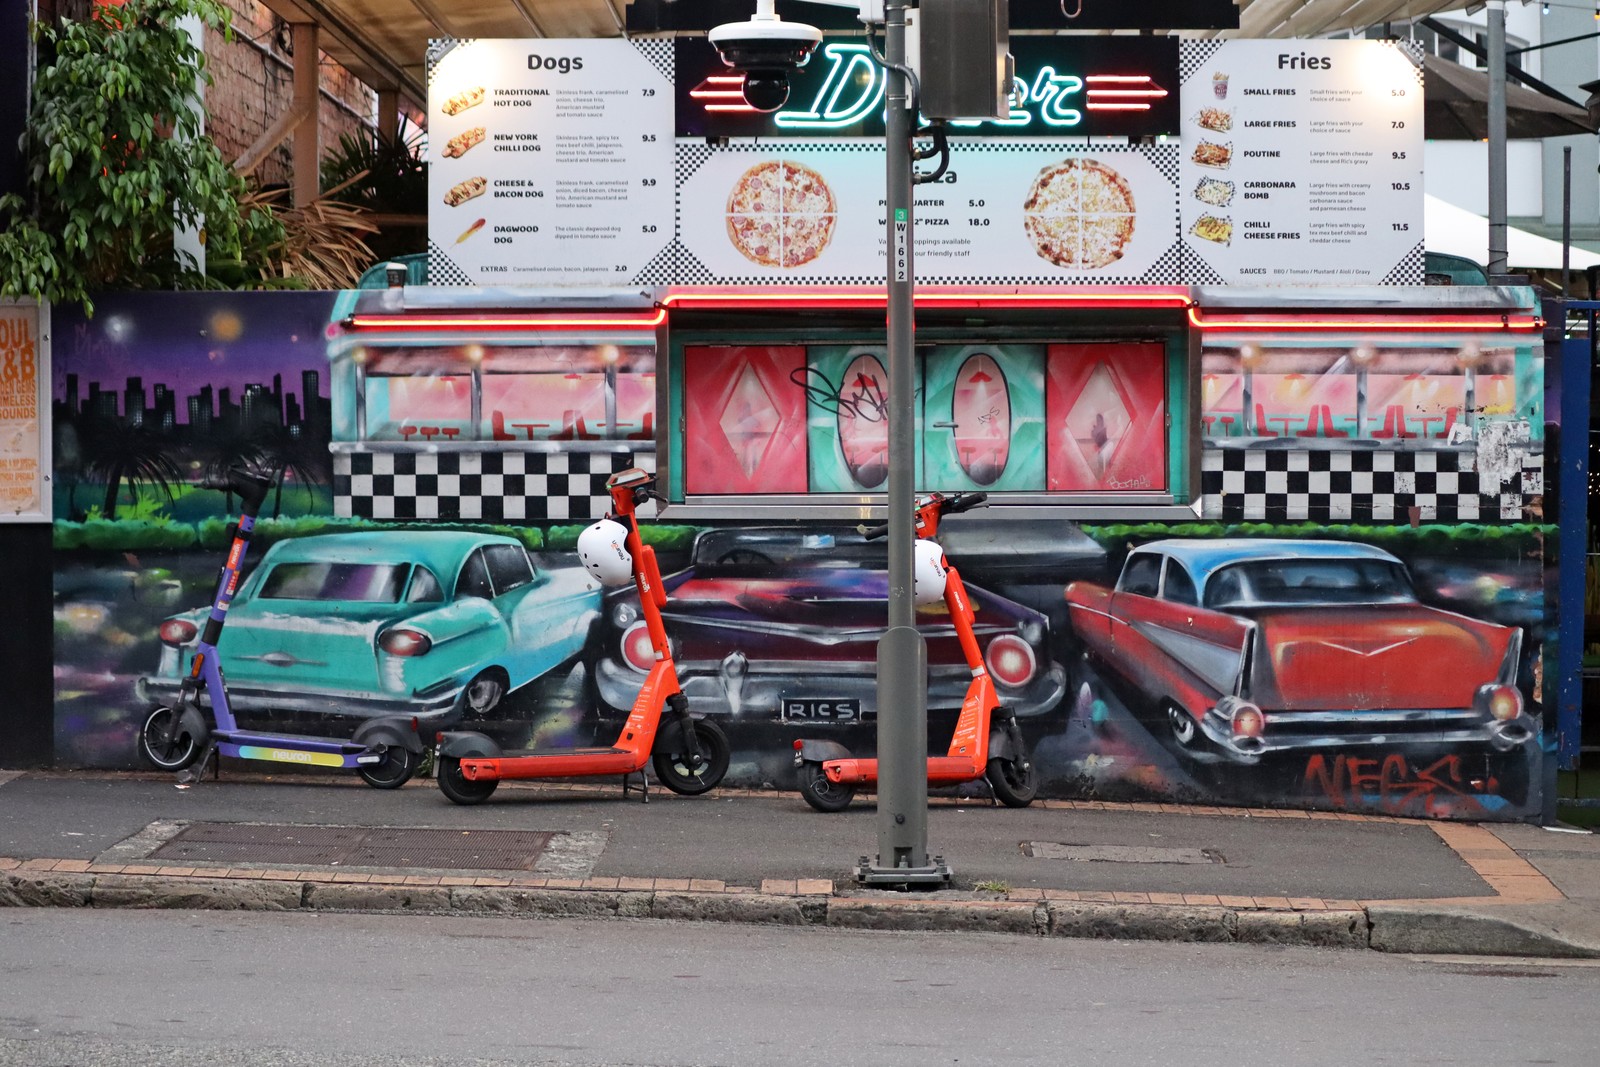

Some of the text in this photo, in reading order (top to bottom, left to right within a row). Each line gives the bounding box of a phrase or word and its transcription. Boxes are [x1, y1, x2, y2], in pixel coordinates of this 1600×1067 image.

[527, 54, 583, 74] Dogs
[1278, 52, 1332, 69] Fries
[0, 319, 34, 349] OUL
[0, 347, 35, 381] &B
[789, 704, 854, 718] RICS
[272, 750, 312, 763] neuron
